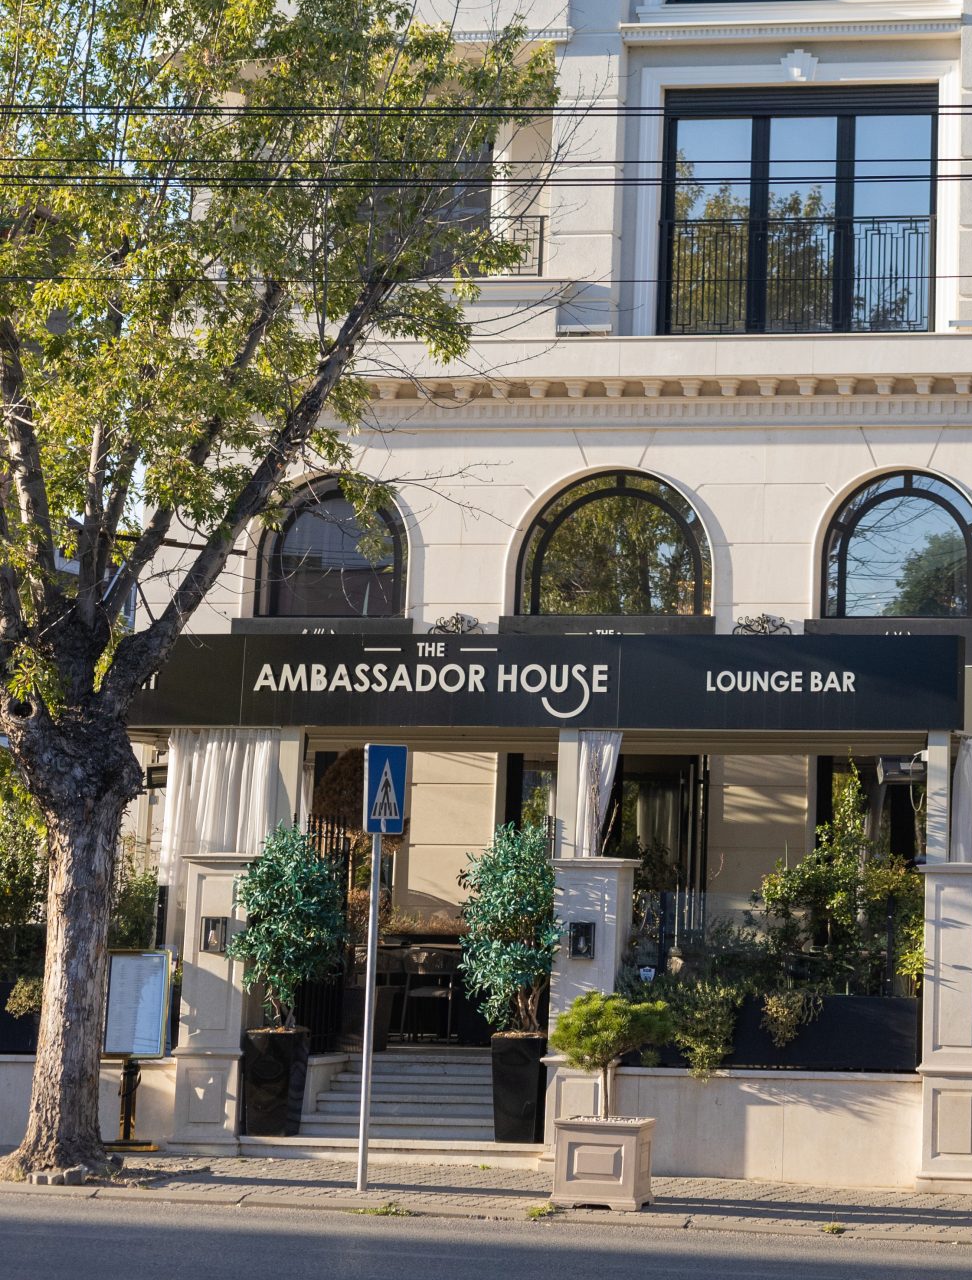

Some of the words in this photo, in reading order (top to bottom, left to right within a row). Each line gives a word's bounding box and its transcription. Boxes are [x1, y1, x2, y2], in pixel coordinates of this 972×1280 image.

[416, 642, 446, 657] THE
[253, 663, 487, 693] AMBASSADOR
[496, 663, 609, 719] HOUSE
[706, 670, 803, 693] LOUNGE
[810, 670, 857, 693] BAR
